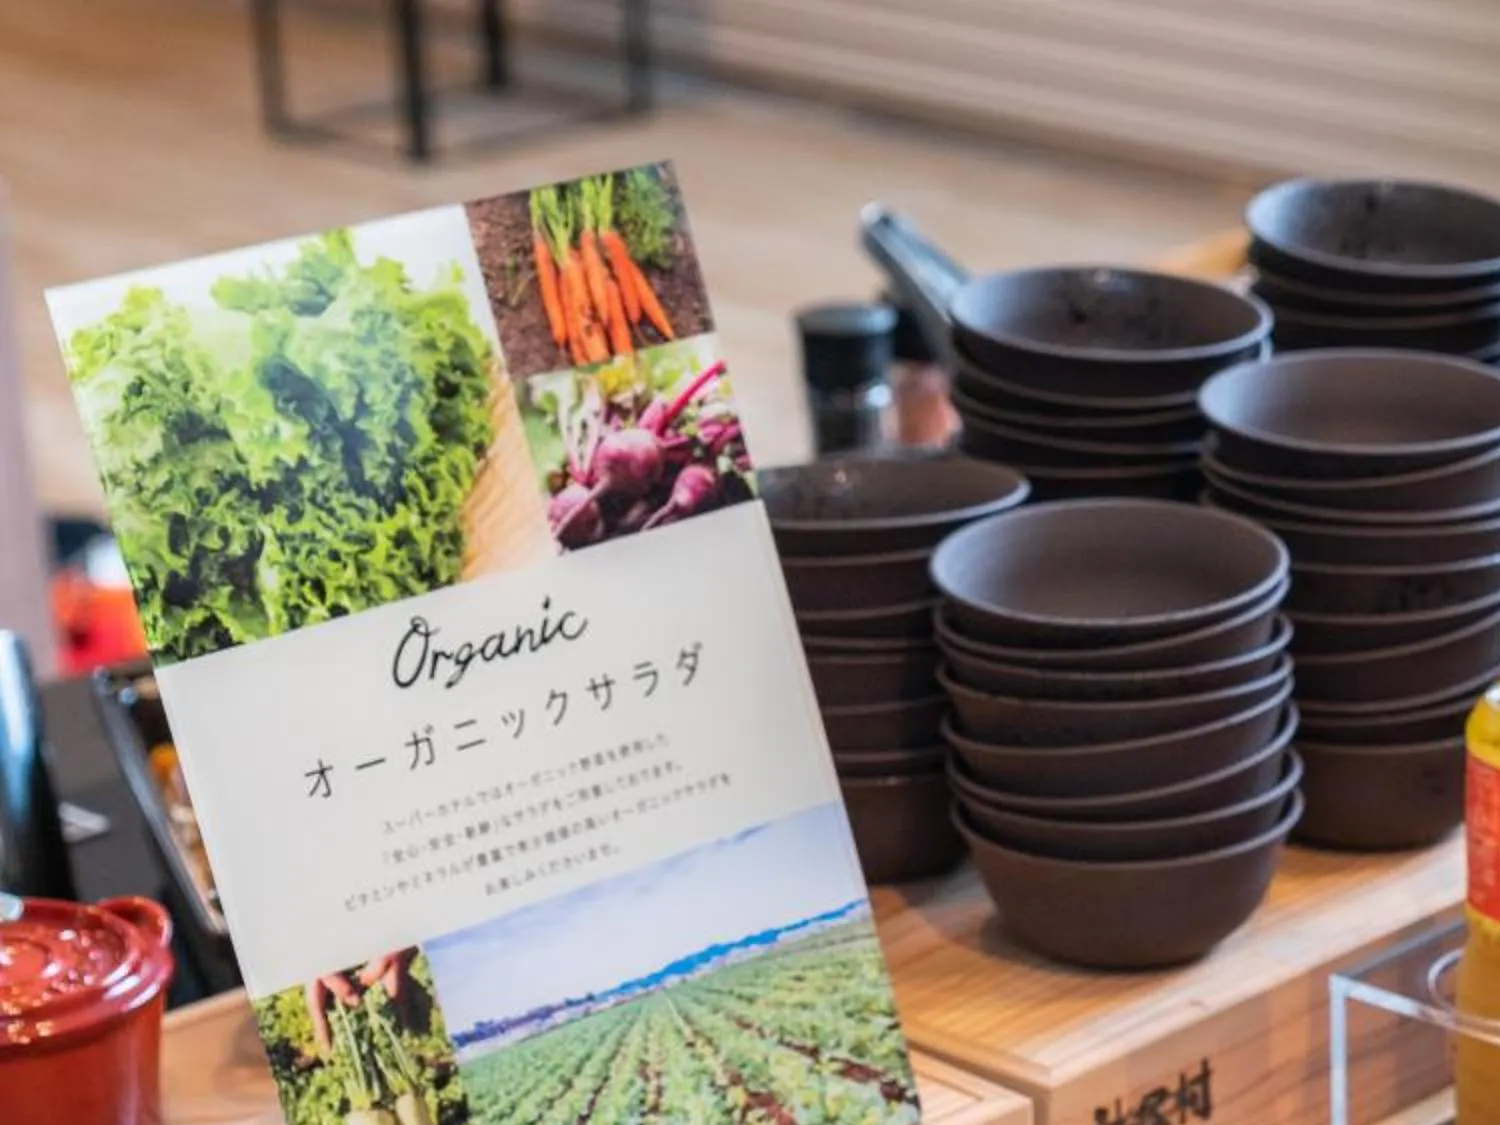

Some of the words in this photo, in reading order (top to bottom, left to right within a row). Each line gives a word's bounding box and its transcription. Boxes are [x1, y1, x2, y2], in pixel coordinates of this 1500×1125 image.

[392, 597, 589, 689] Organic
[304, 642, 704, 799] オーガニックサラダ
